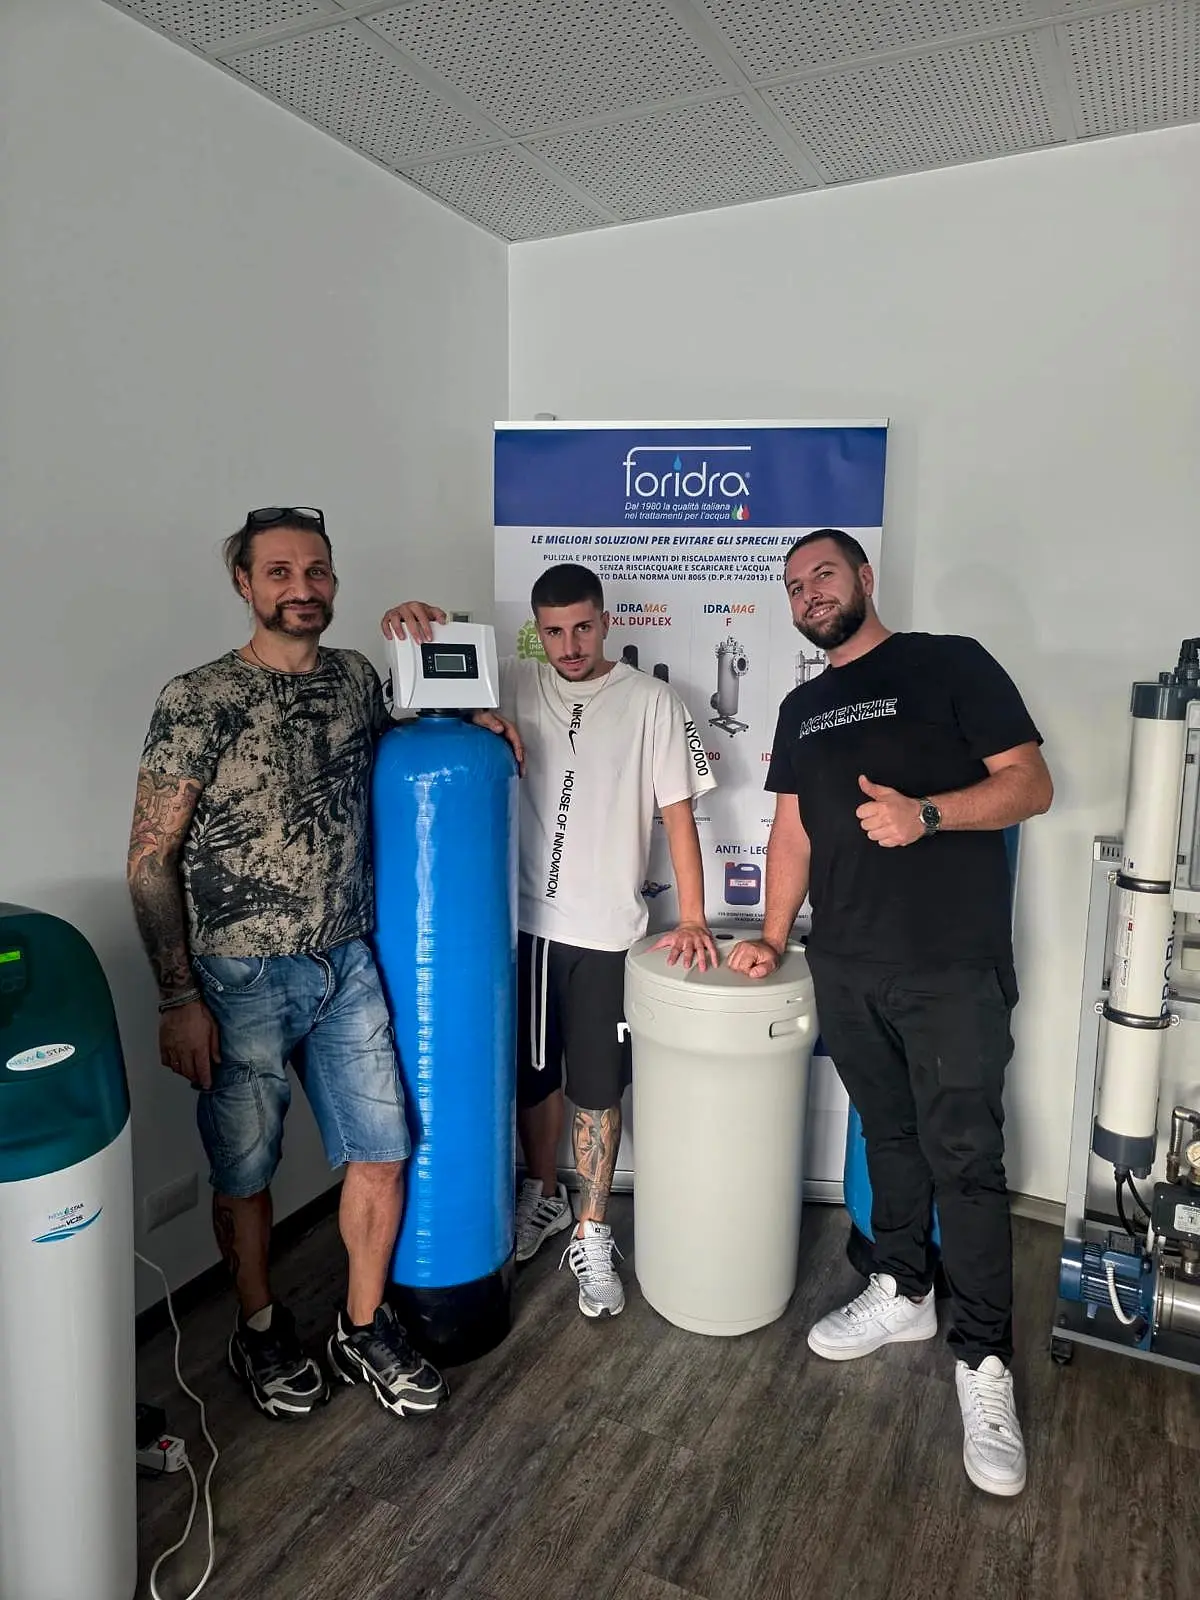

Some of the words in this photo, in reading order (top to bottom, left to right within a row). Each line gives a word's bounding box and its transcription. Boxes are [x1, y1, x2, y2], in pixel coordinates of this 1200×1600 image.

[625, 502, 639, 511] Dal
[642, 502, 660, 511] 1980
[663, 502, 670, 511] la
[672, 502, 699, 514] qualità
[701, 502, 731, 511] italiana
[625, 512, 637, 520] nei
[639, 512, 682, 520] trattamenti
[684, 513, 698, 522] per
[700, 511, 730, 522] l'acqua
[531, 535, 543, 544] LE
[545, 535, 592, 545] MIGLIORI
[594, 536, 649, 545] SOLUZIONI
[651, 536, 670, 545] PER
[673, 536, 715, 545] EVITARE
[717, 537, 733, 545] GLI
[735, 537, 778, 546] SPRECHI
[626, 564, 683, 572] RISCIACQUARE
[736, 564, 770, 573] L'ACQUA
[734, 573, 767, 582] 74/2013)
[616, 603, 668, 613] IDRAMAG
[703, 604, 755, 614] IDRAMAG
[612, 617, 625, 625] XL
[629, 617, 672, 625] DUPLEX
[726, 617, 732, 626] F
[570, 703, 584, 729] NIKE
[684, 720, 709, 776] NYC/000
[558, 770, 575, 812] HOUSE
[556, 813, 568, 831] OF
[715, 845, 740, 854] ANTI
[546, 832, 565, 898] INNOVATION
[46, 1045, 73, 1057] STAR
